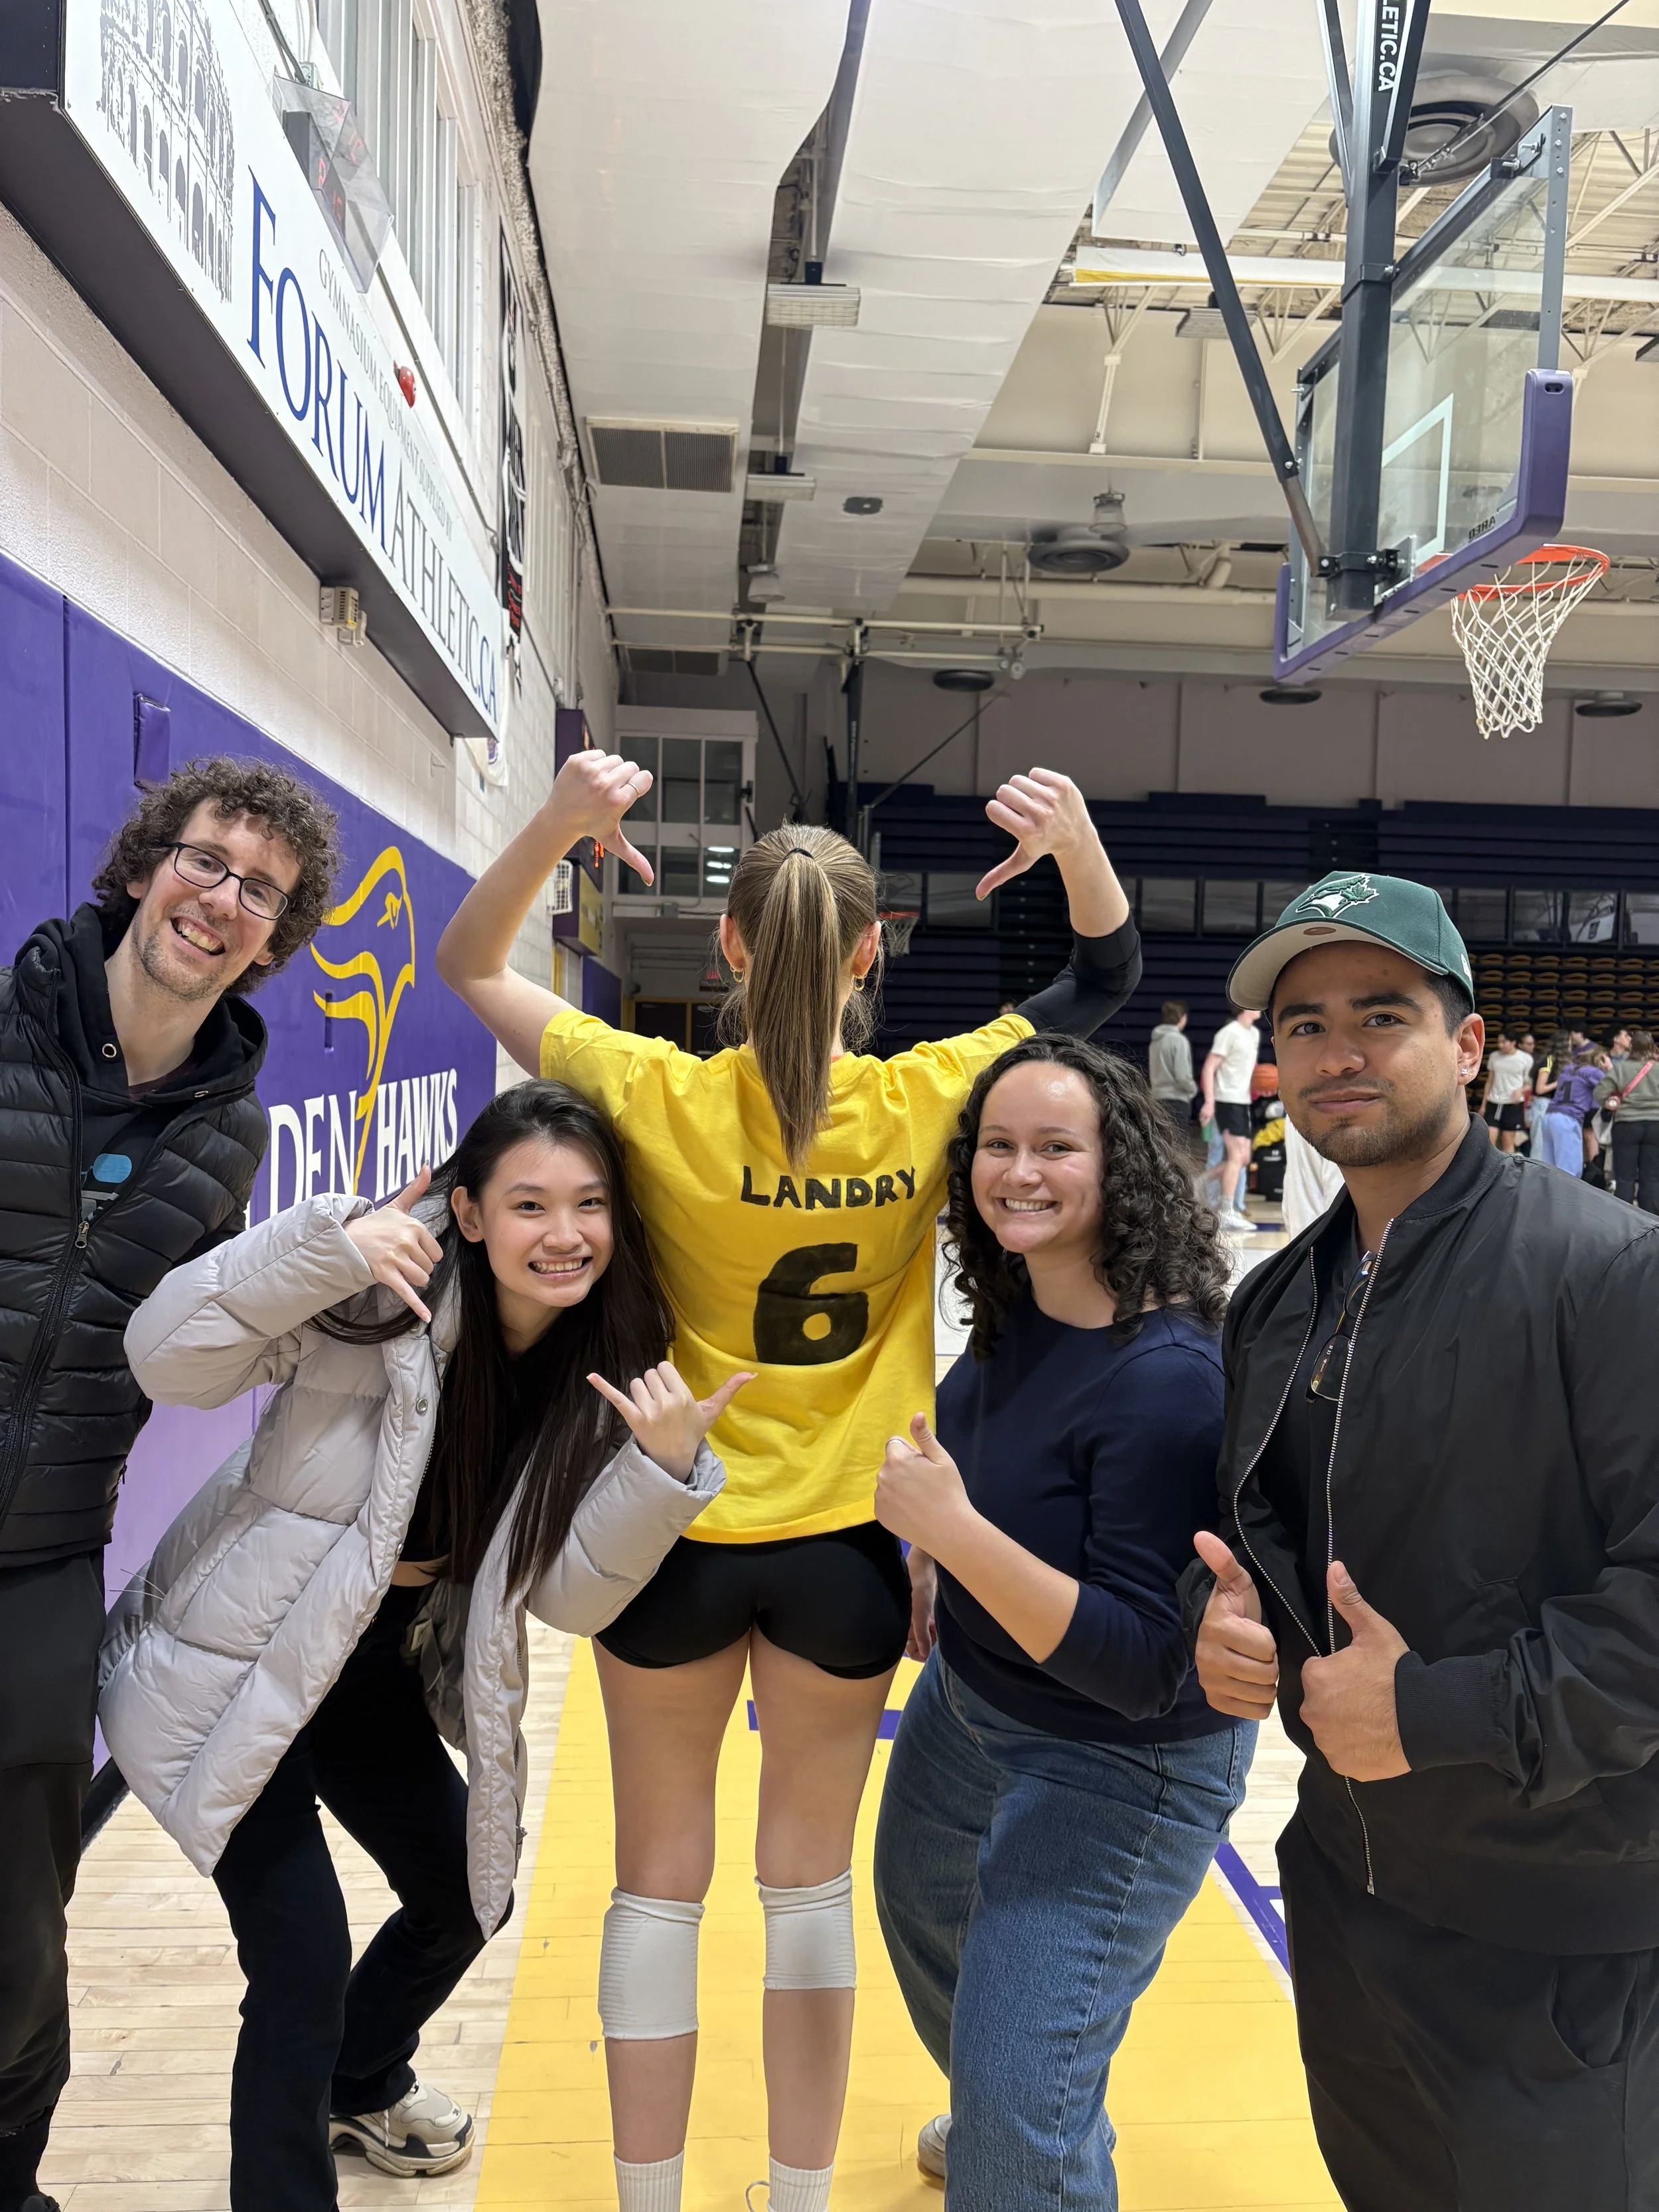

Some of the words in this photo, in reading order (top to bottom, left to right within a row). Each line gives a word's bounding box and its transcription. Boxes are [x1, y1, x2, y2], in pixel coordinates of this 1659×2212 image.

[1378, 0, 1400, 92] ETIC.CA
[319, 248, 377, 392] GYMNASIUM
[378, 370, 419, 476] EQUIPMENT
[419, 459, 445, 527] SUPPLIED
[246, 1090, 358, 1229] DEN
[375, 1068, 457, 1203] HAWKS
[741, 1165, 916, 1210] LANDRY
[753, 1242, 869, 1366] 6
